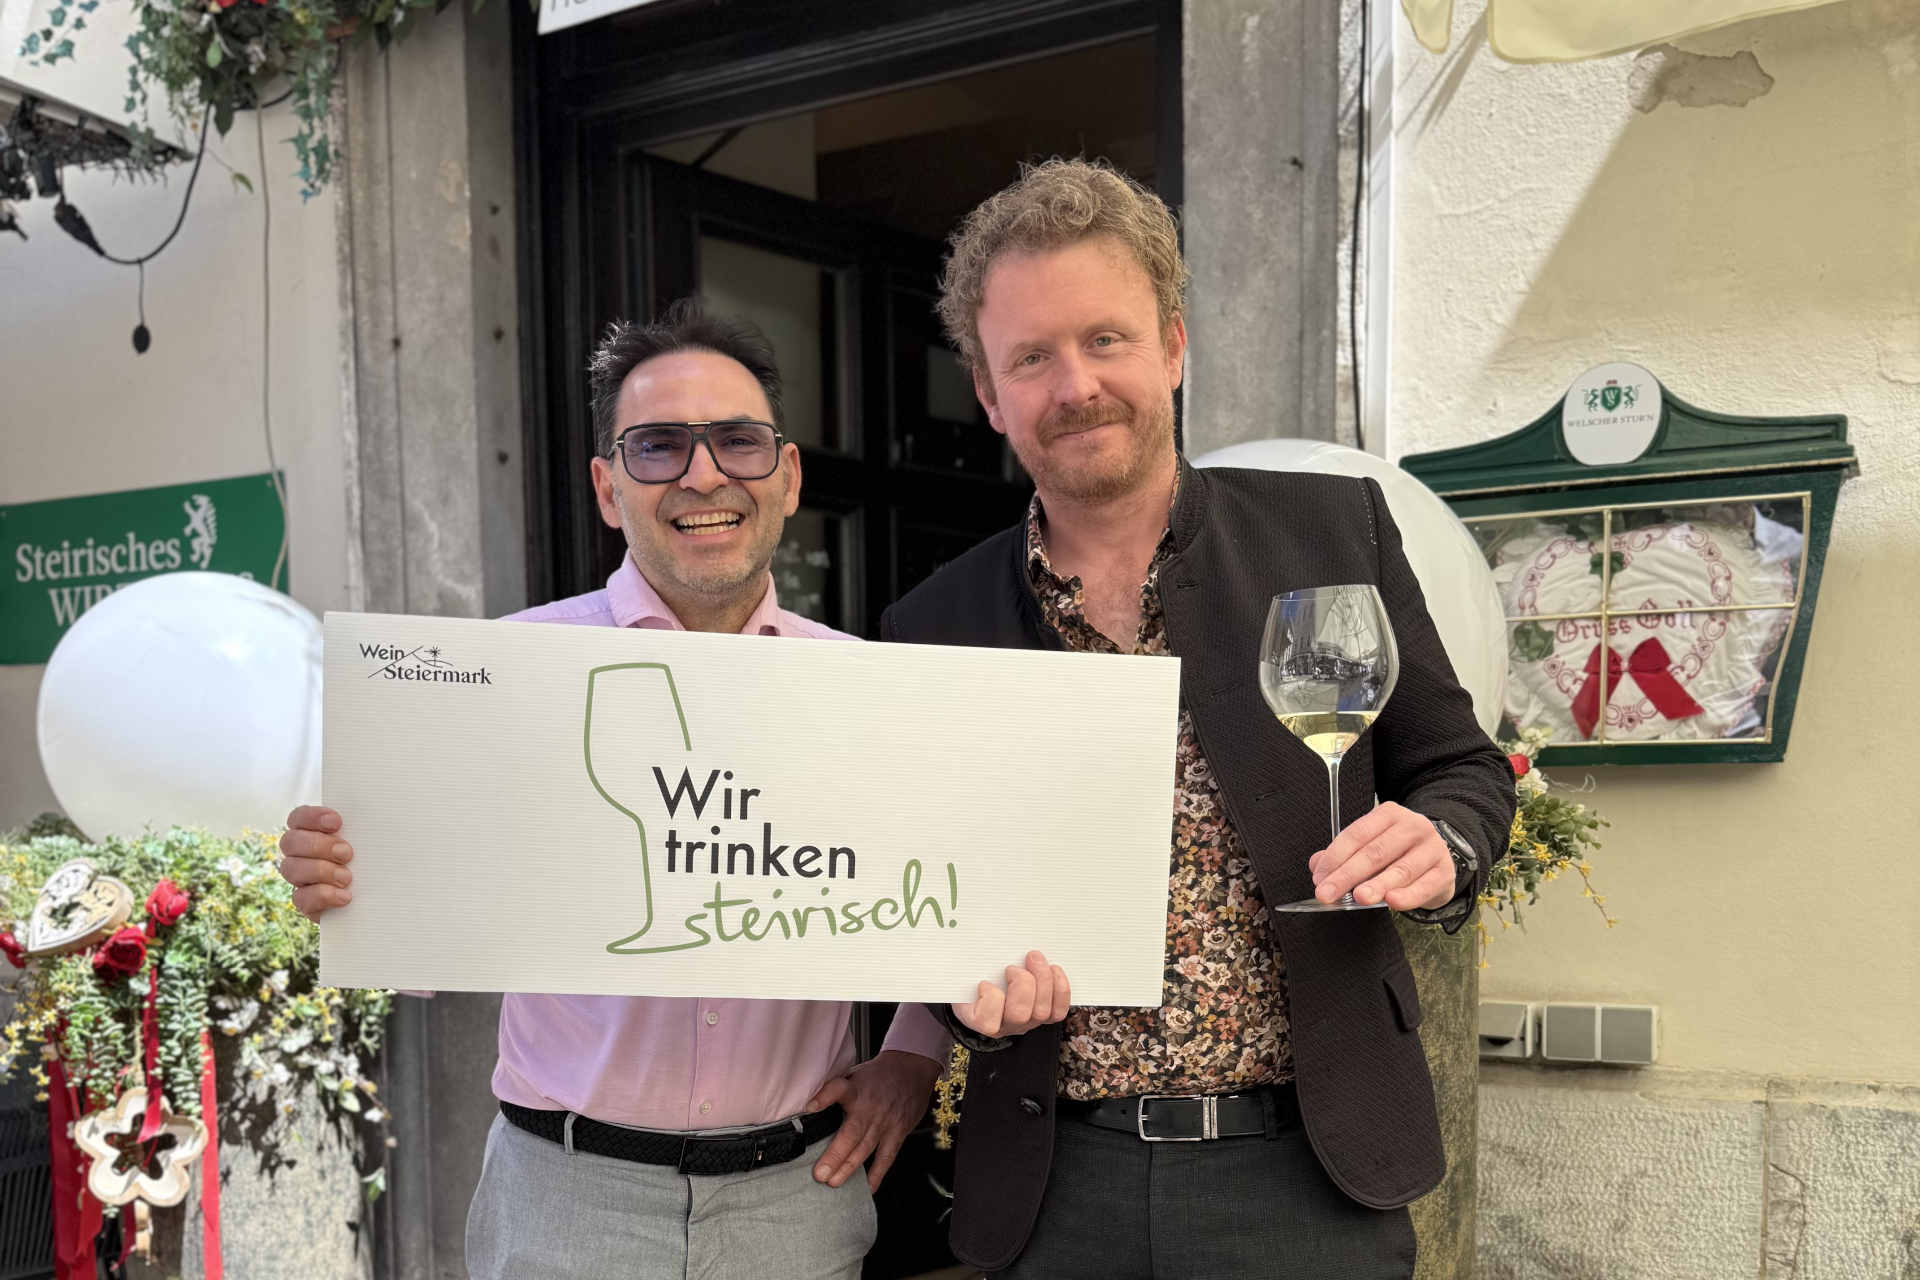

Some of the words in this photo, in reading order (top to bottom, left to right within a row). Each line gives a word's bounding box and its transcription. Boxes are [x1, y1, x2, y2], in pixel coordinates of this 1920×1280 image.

[15, 531, 182, 583] Steirisches
[359, 643, 406, 661] Wein
[383, 663, 493, 685] Steiermark
[652, 765, 761, 821] Wir
[665, 822, 856, 879] trinken
[684, 858, 958, 946] steirisch!
